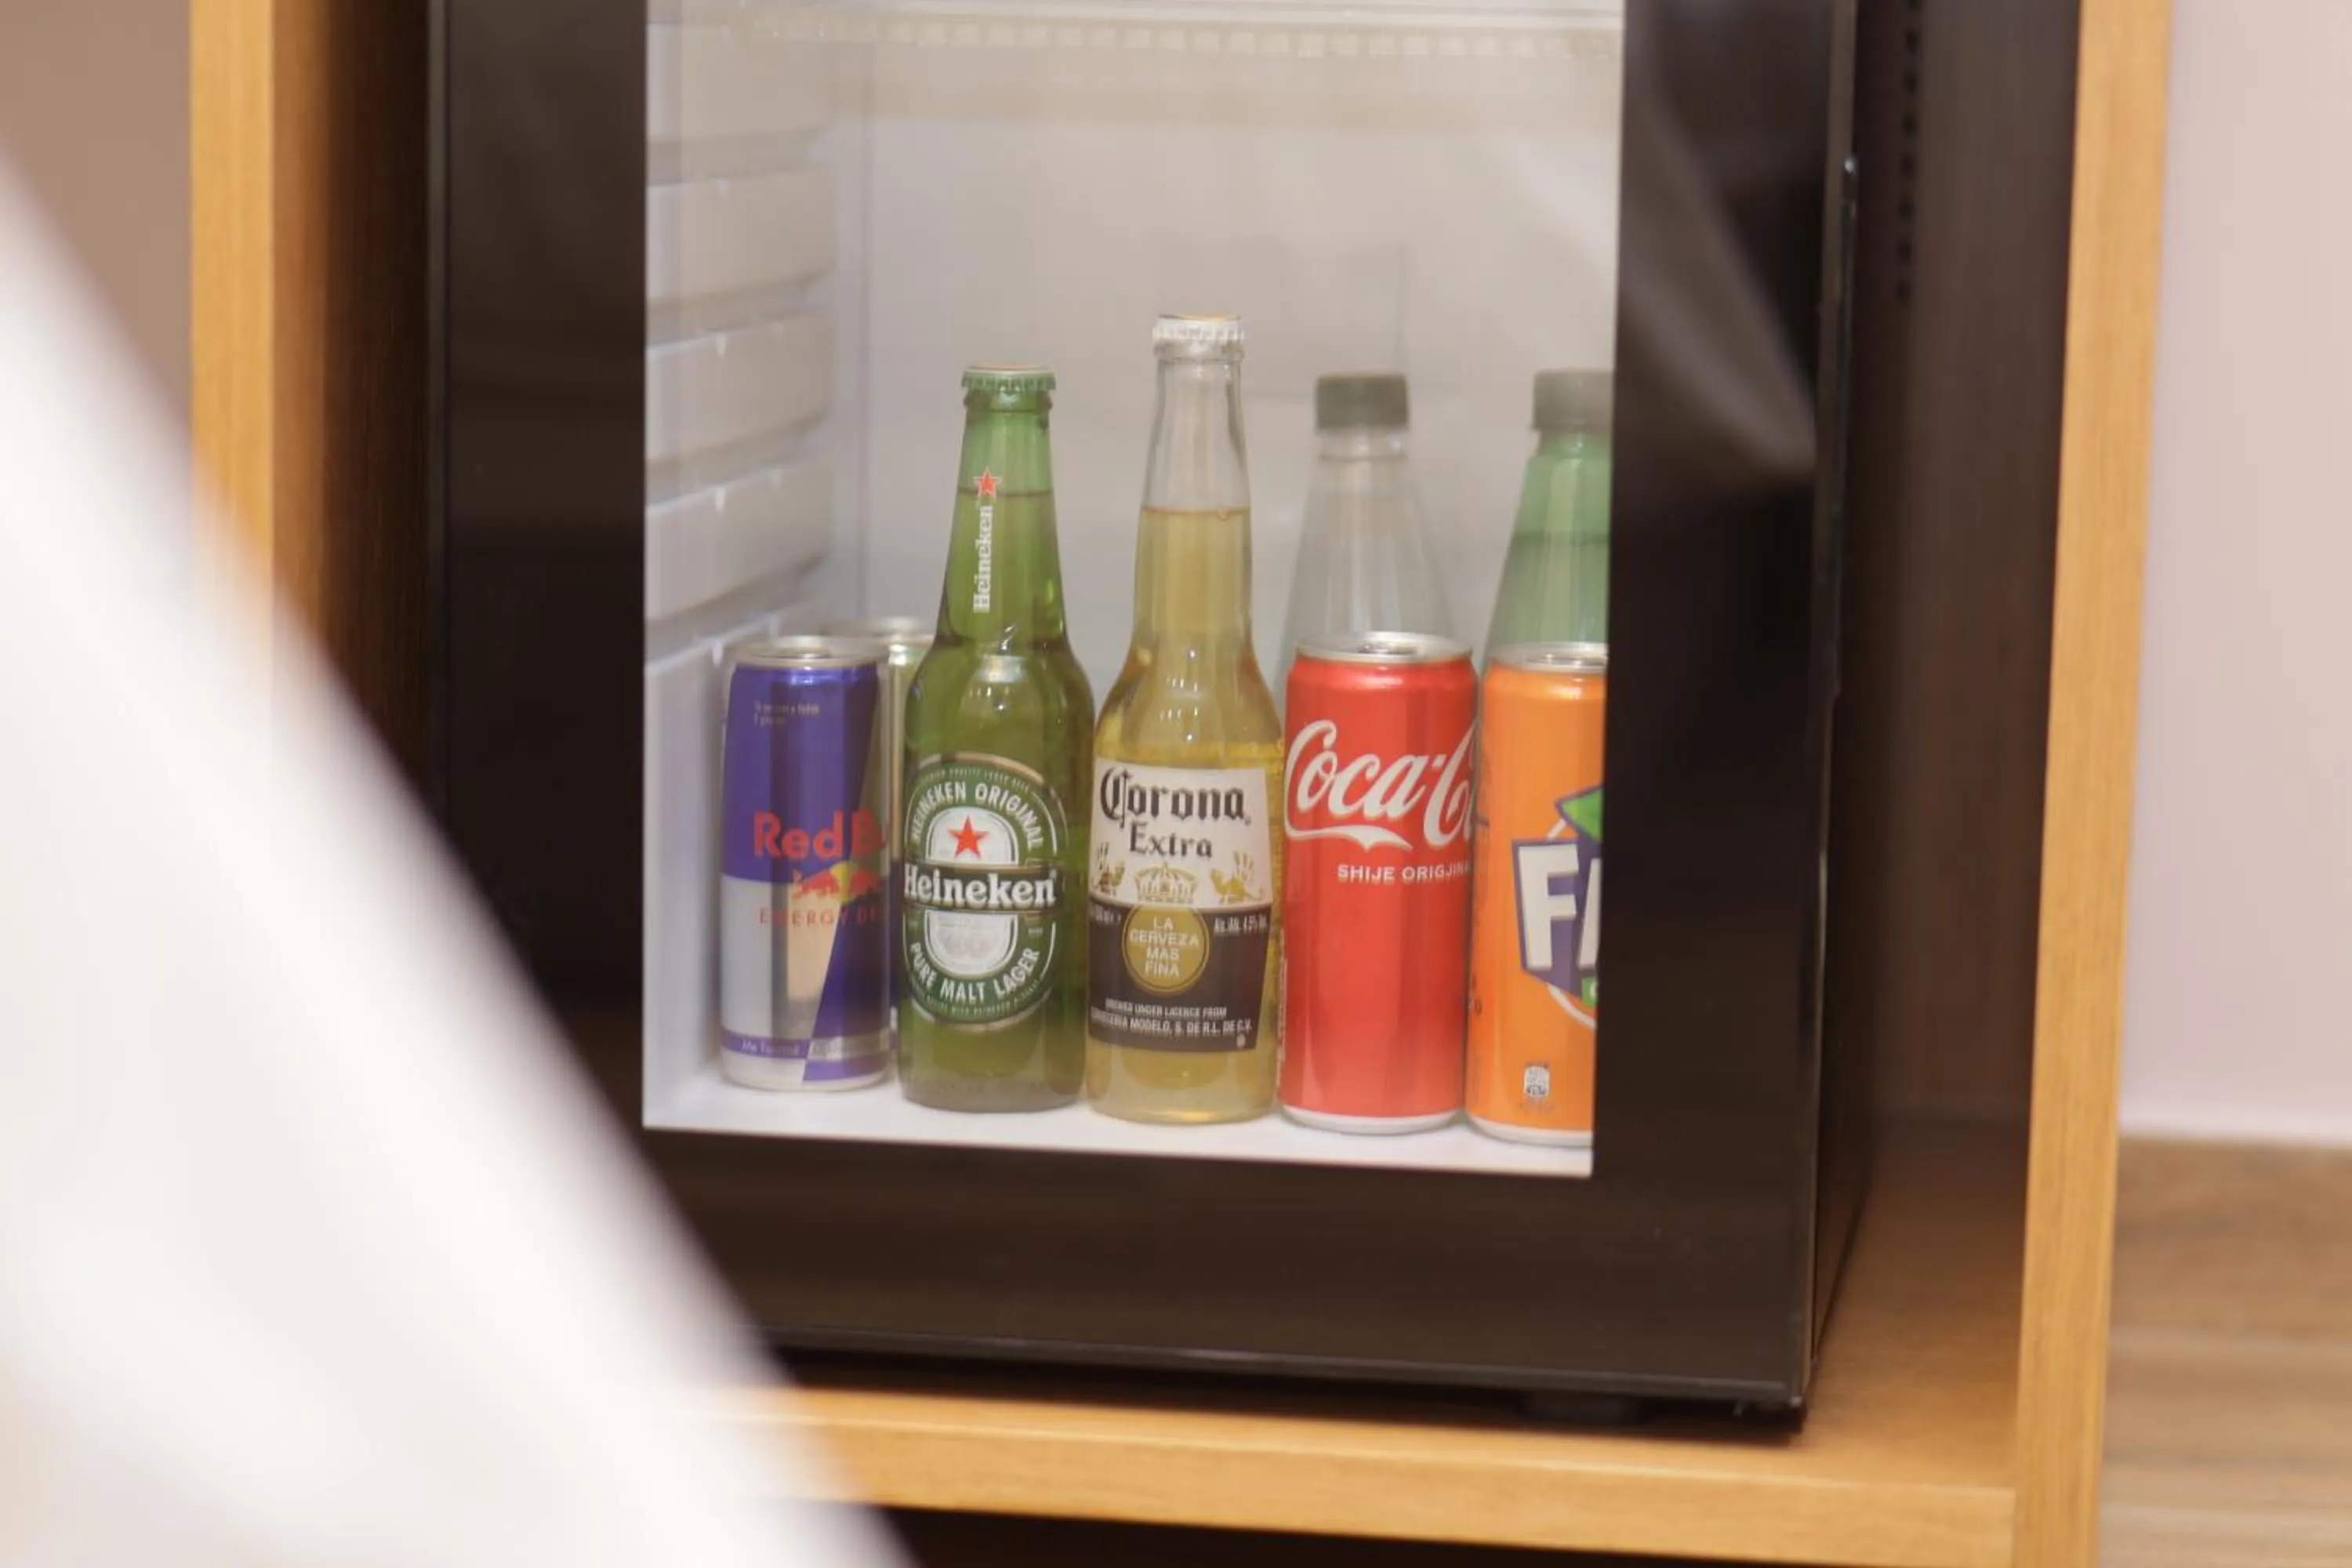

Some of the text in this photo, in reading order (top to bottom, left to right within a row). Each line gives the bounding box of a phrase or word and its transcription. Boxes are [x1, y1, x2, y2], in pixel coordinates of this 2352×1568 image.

[973, 505, 993, 613] Heineken
[910, 781, 967, 847] HEINEKEN
[975, 782, 1044, 852] ORIGINAL
[1100, 767, 1245, 829] Corona
[754, 808, 844, 858] Red
[1130, 821, 1212, 858] Extra
[904, 863, 1056, 907] Heineken
[1338, 863, 1395, 882] SHIJE
[1130, 928, 1200, 947] CERVEZA
[1153, 916, 1174, 930] LA
[910, 942, 937, 990] PURE
[940, 978, 985, 1004] MALT
[993, 947, 1040, 999] LAGER
[1145, 961, 1180, 976] FINA
[1187, 1021, 1200, 1034] DE
[1203, 1007, 1228, 1019] FROM
